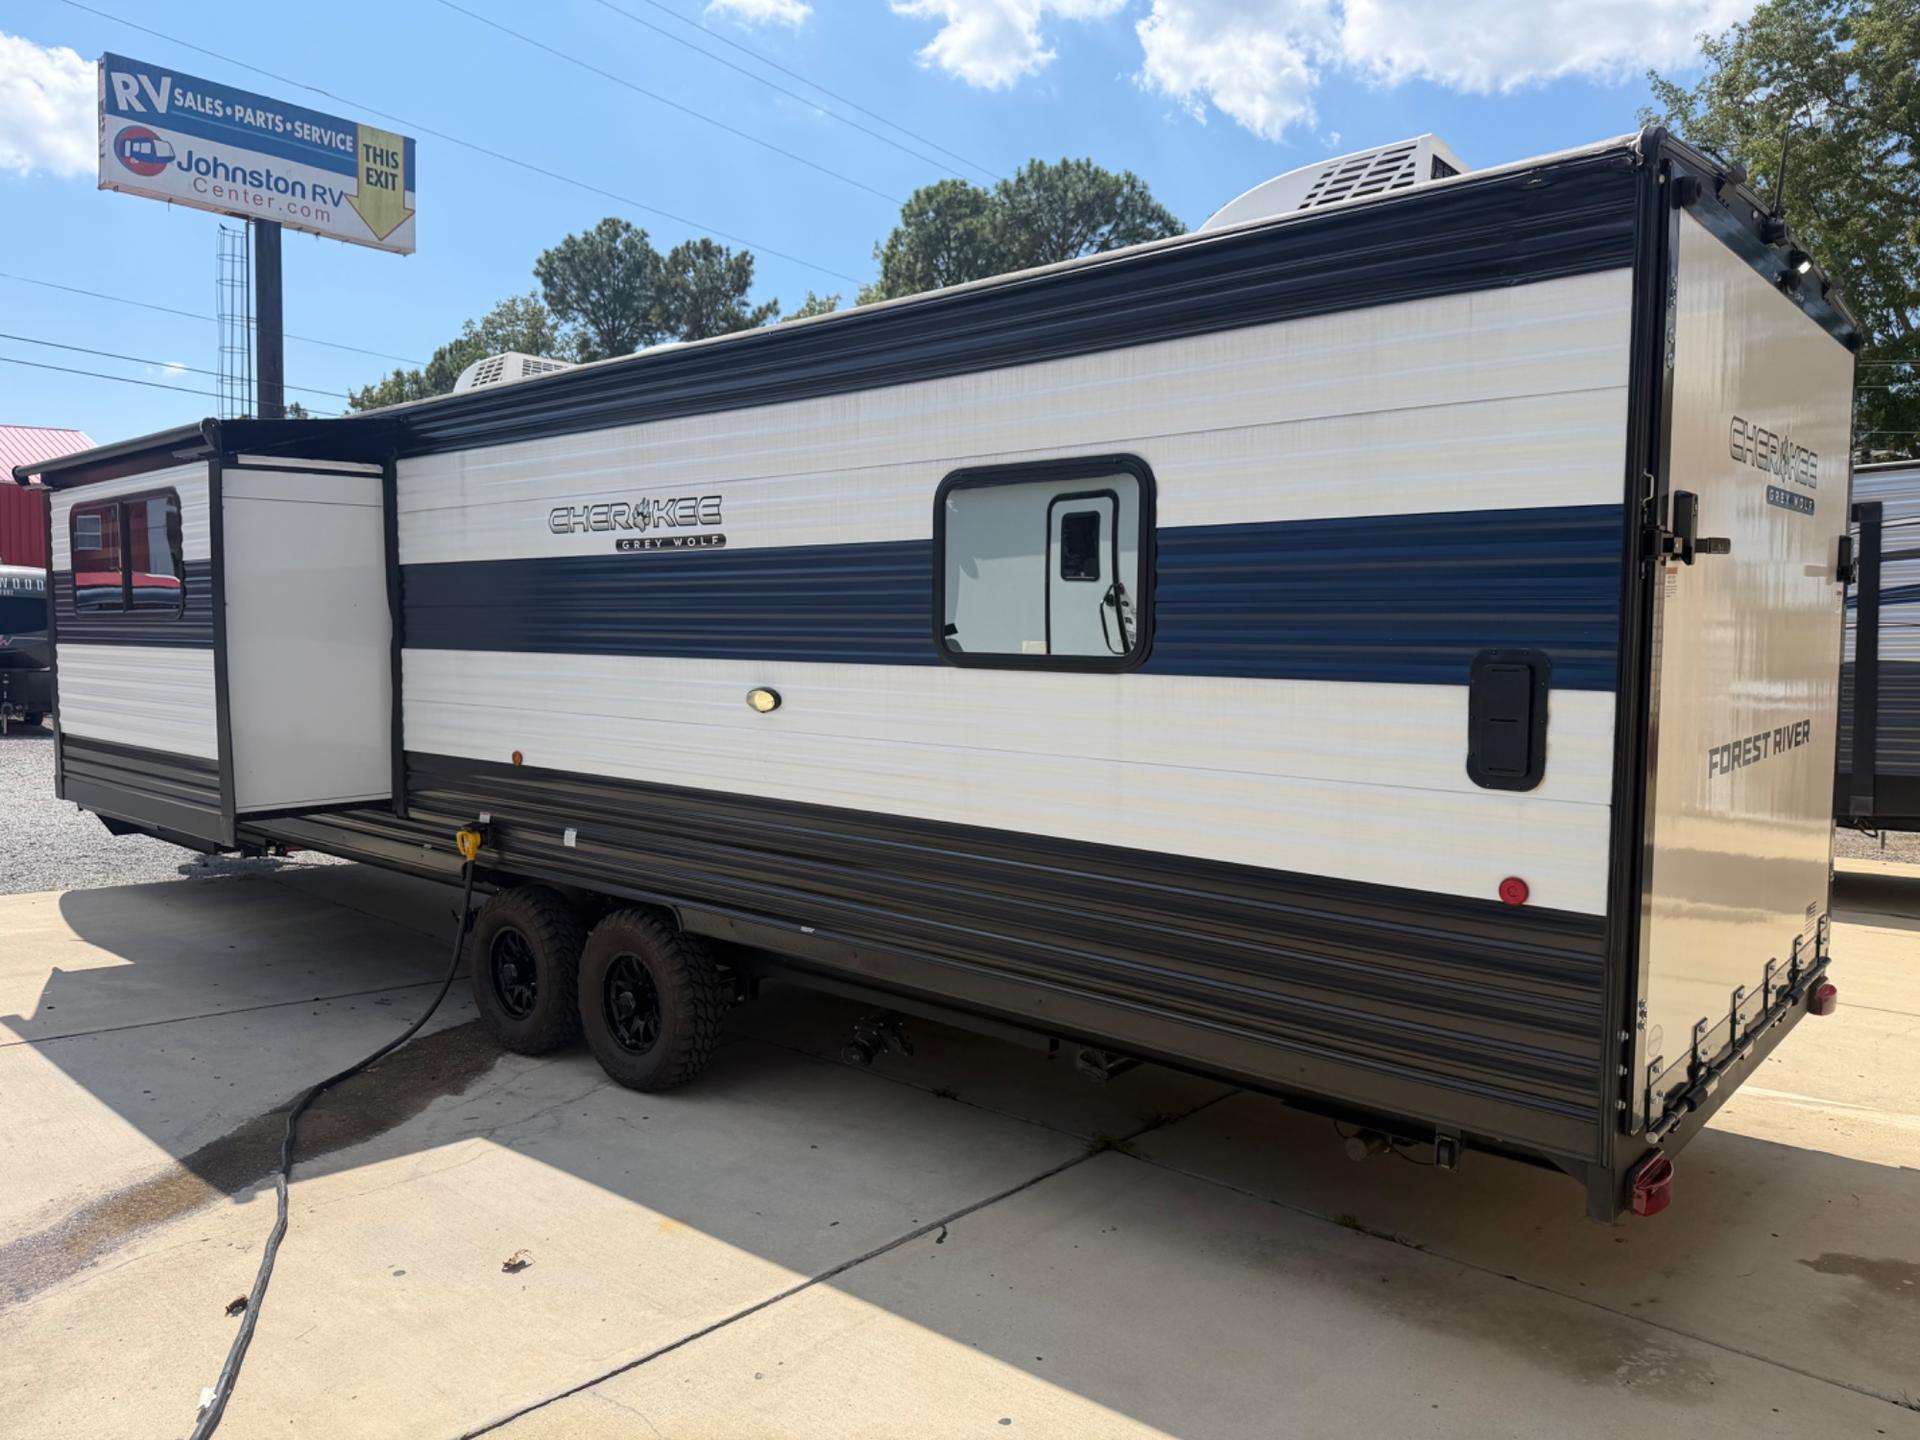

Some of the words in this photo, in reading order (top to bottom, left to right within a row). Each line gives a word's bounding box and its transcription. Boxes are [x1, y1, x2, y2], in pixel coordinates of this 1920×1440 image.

[110, 71, 172, 114] RV
[174, 87, 223, 118] SALES
[235, 104, 284, 133] PARTS
[295, 120, 354, 153] SERVICE
[362, 143, 399, 169] THIS
[177, 149, 306, 199] Johnston
[312, 183, 344, 208] RV
[366, 165, 398, 191] EXIT
[193, 177, 330, 223] Center.com
[1768, 488, 1790, 505] GREY
[1793, 495, 1813, 511] WOLF
[621, 539, 662, 550] GREY
[673, 535, 719, 548] WOLF
[1708, 730, 1771, 779] FOREST
[1773, 719, 1810, 755] RIVER
